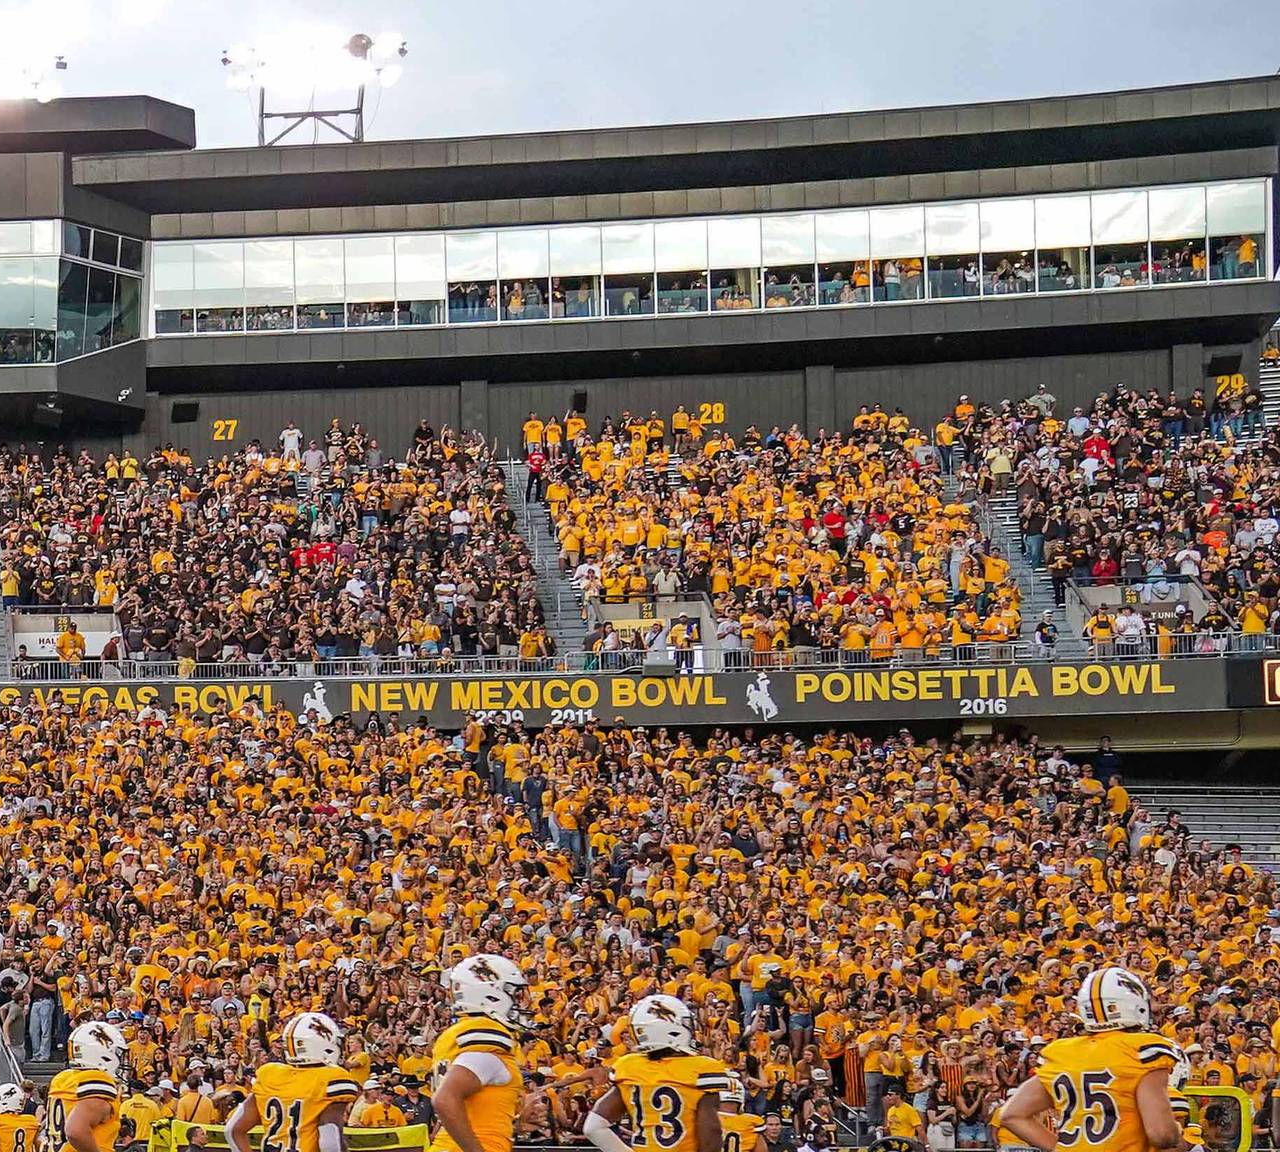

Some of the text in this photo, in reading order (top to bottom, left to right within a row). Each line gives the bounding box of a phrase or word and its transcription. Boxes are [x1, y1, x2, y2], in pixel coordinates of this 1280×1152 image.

[700, 402, 724, 424] 28
[213, 420, 238, 441] 27
[351, 677, 727, 712] NEW MEXICO BOWL
[796, 664, 1175, 702] POINSETTIA BOWL
[33, 686, 160, 712] VEGAS
[959, 698, 1007, 715] 2016
[477, 710, 525, 725] 209
[631, 1084, 685, 1149] 13
[1053, 1067, 1121, 1147] 25
